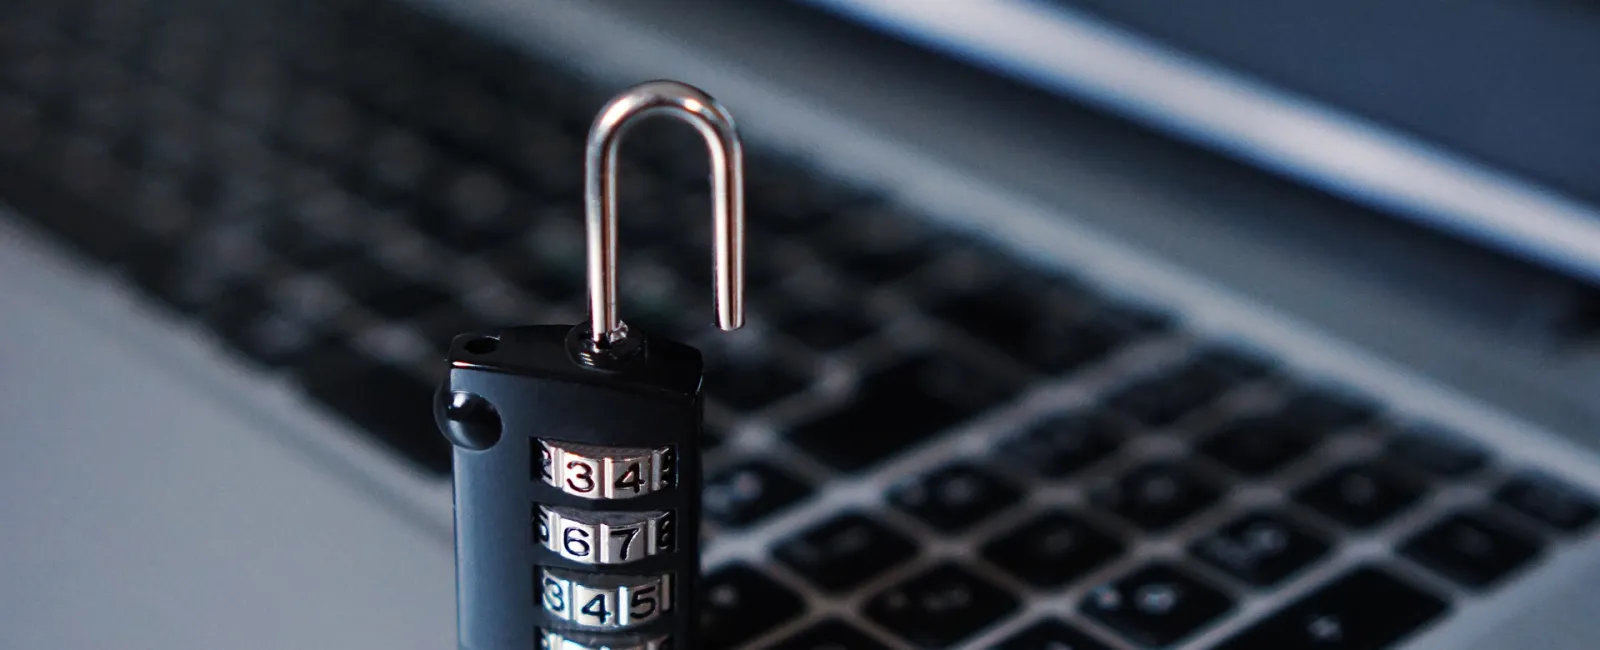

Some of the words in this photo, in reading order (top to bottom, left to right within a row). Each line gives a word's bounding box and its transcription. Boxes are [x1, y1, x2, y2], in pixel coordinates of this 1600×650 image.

[566, 460, 595, 493] 3
[614, 462, 645, 494] 4
[563, 527, 590, 557] 6
[610, 527, 640, 561] 7
[543, 577, 564, 612] 3
[581, 593, 612, 625] 4
[630, 587, 657, 619] 5
